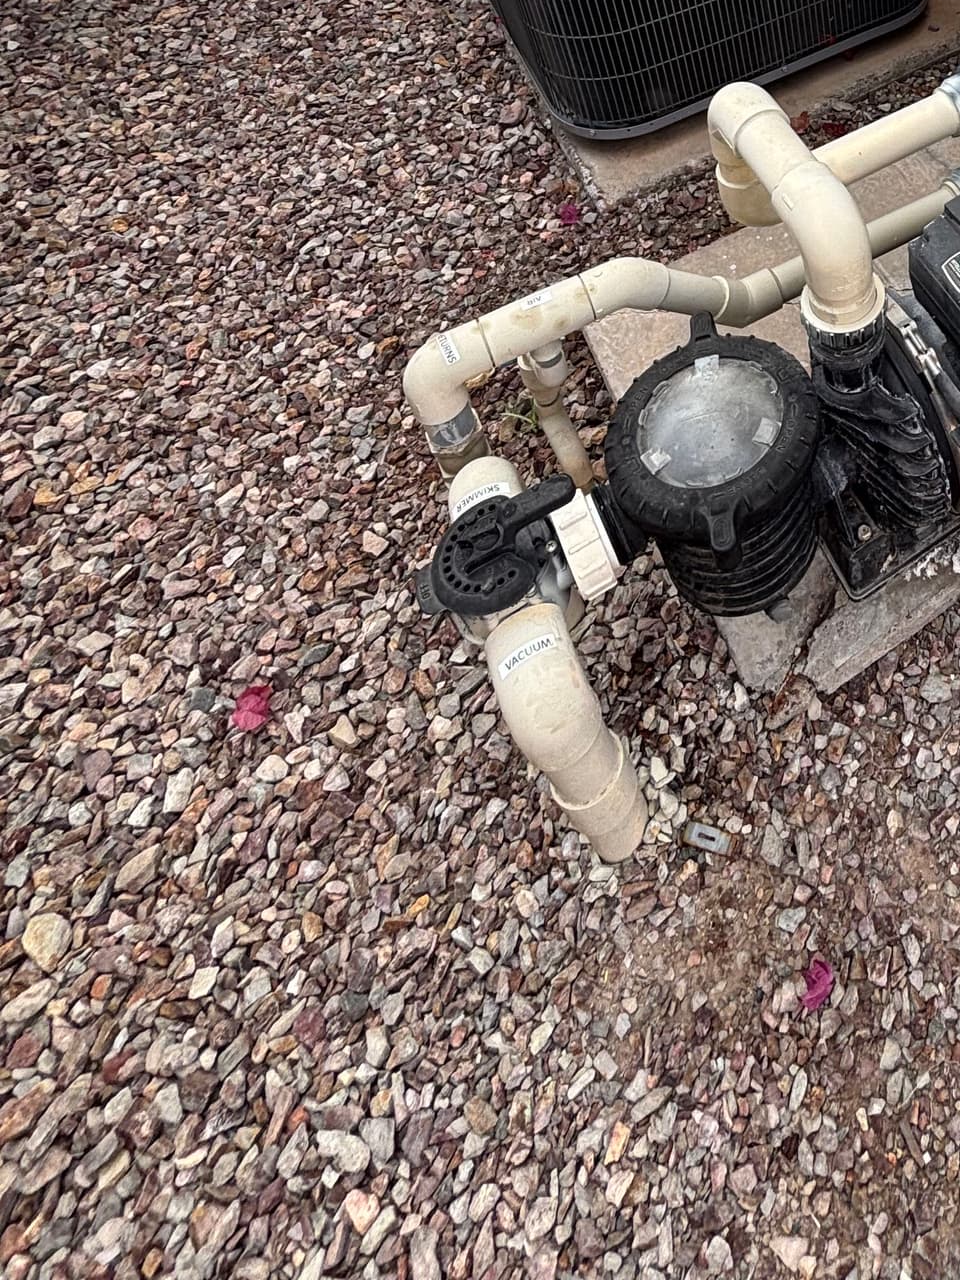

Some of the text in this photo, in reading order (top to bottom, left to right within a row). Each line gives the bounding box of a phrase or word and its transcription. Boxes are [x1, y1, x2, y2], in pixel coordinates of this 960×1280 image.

[527, 295, 542, 306] AIR
[437, 334, 457, 364] ETURNS
[456, 483, 500, 513] SKIMMER
[504, 637, 554, 671] VACUUM
